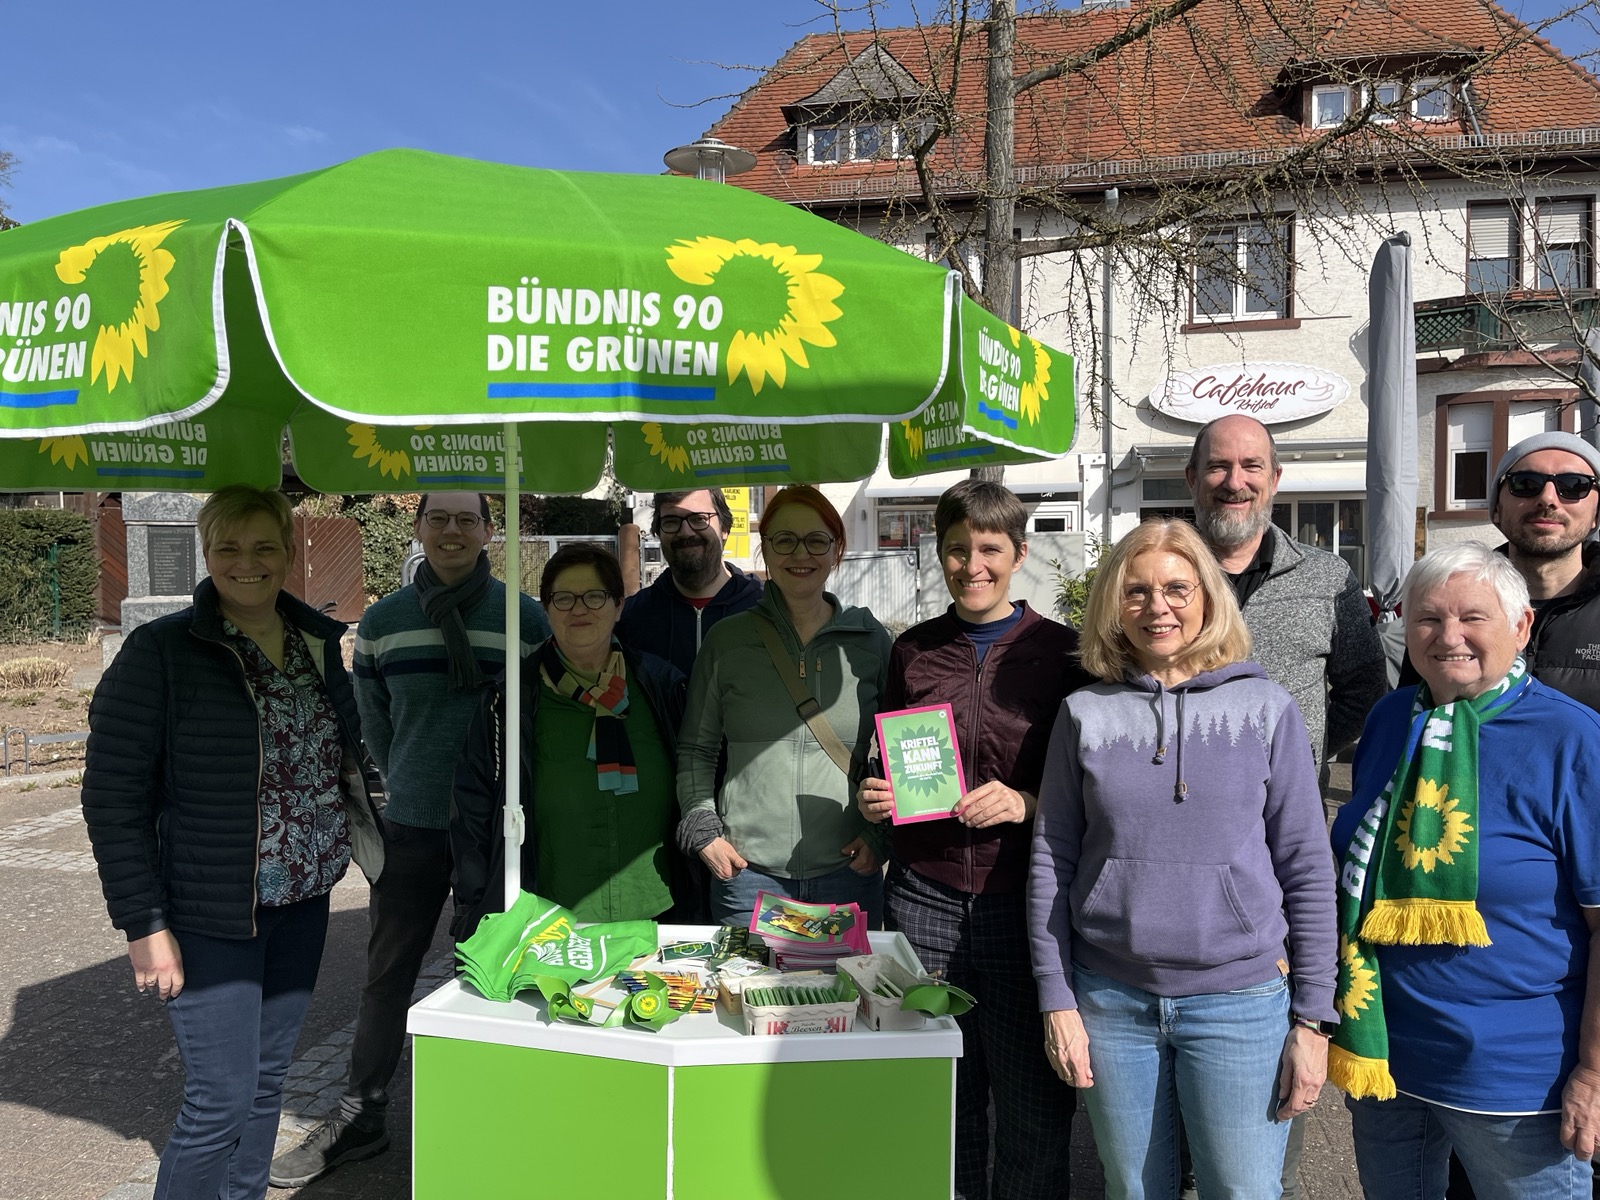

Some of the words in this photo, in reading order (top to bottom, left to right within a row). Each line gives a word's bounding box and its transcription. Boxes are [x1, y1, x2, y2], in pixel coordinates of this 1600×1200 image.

[54, 293, 91, 333] 90
[487, 276, 661, 327] BÜNDNIS
[673, 294, 723, 331] 90
[487, 334, 550, 372] DIE
[566, 326, 719, 376] GRÜNEN
[1010, 353, 1021, 380] 90
[1192, 373, 1305, 406] Caféhaus
[900, 736, 939, 750] KRIFTEL
[902, 747, 941, 764] KANN
[904, 760, 943, 775] ZUKUNFT
